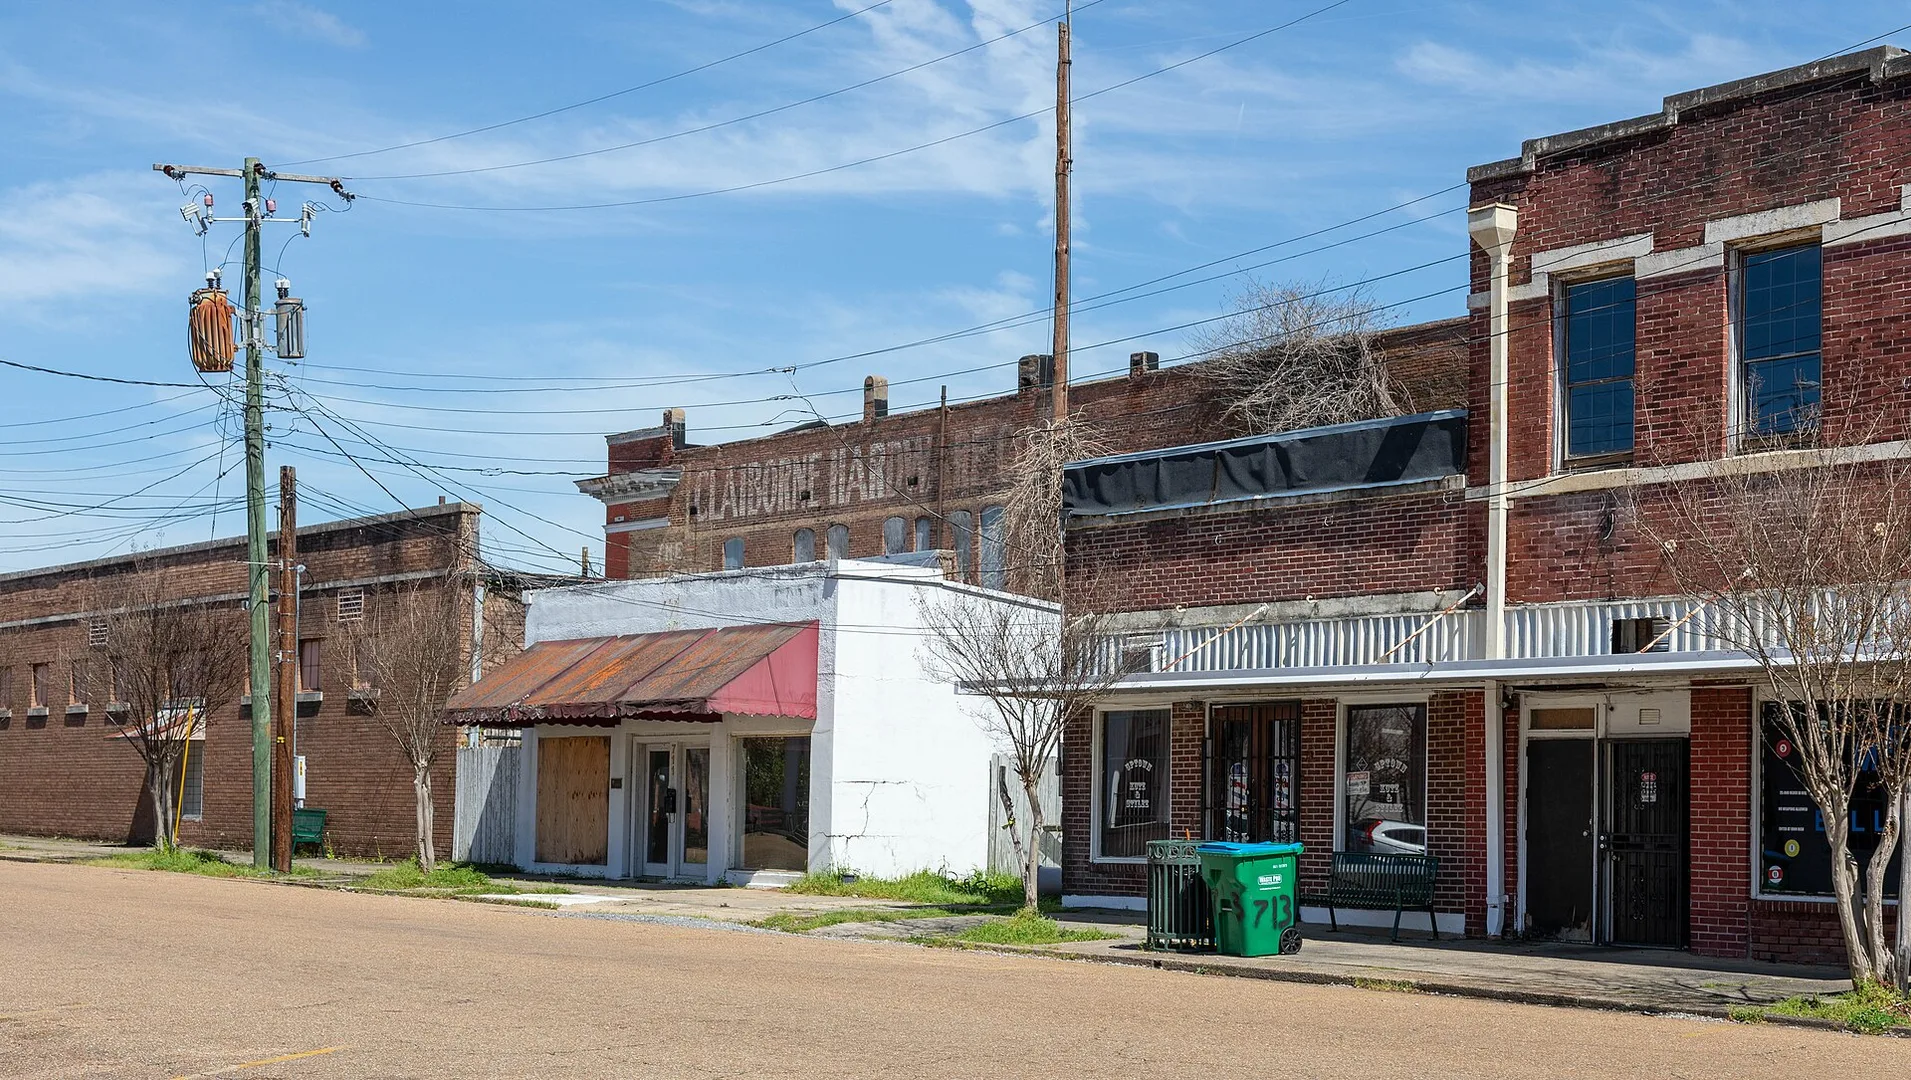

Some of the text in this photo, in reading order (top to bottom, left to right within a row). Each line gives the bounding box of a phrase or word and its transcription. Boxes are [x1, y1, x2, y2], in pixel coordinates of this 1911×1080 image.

[694, 451, 822, 521] CLAIBORNE
[1124, 758, 1153, 771] UPTOWN
[1373, 758, 1408, 773] UPTOWN
[1386, 793, 1393, 803] &
[1253, 894, 1293, 931] 713
